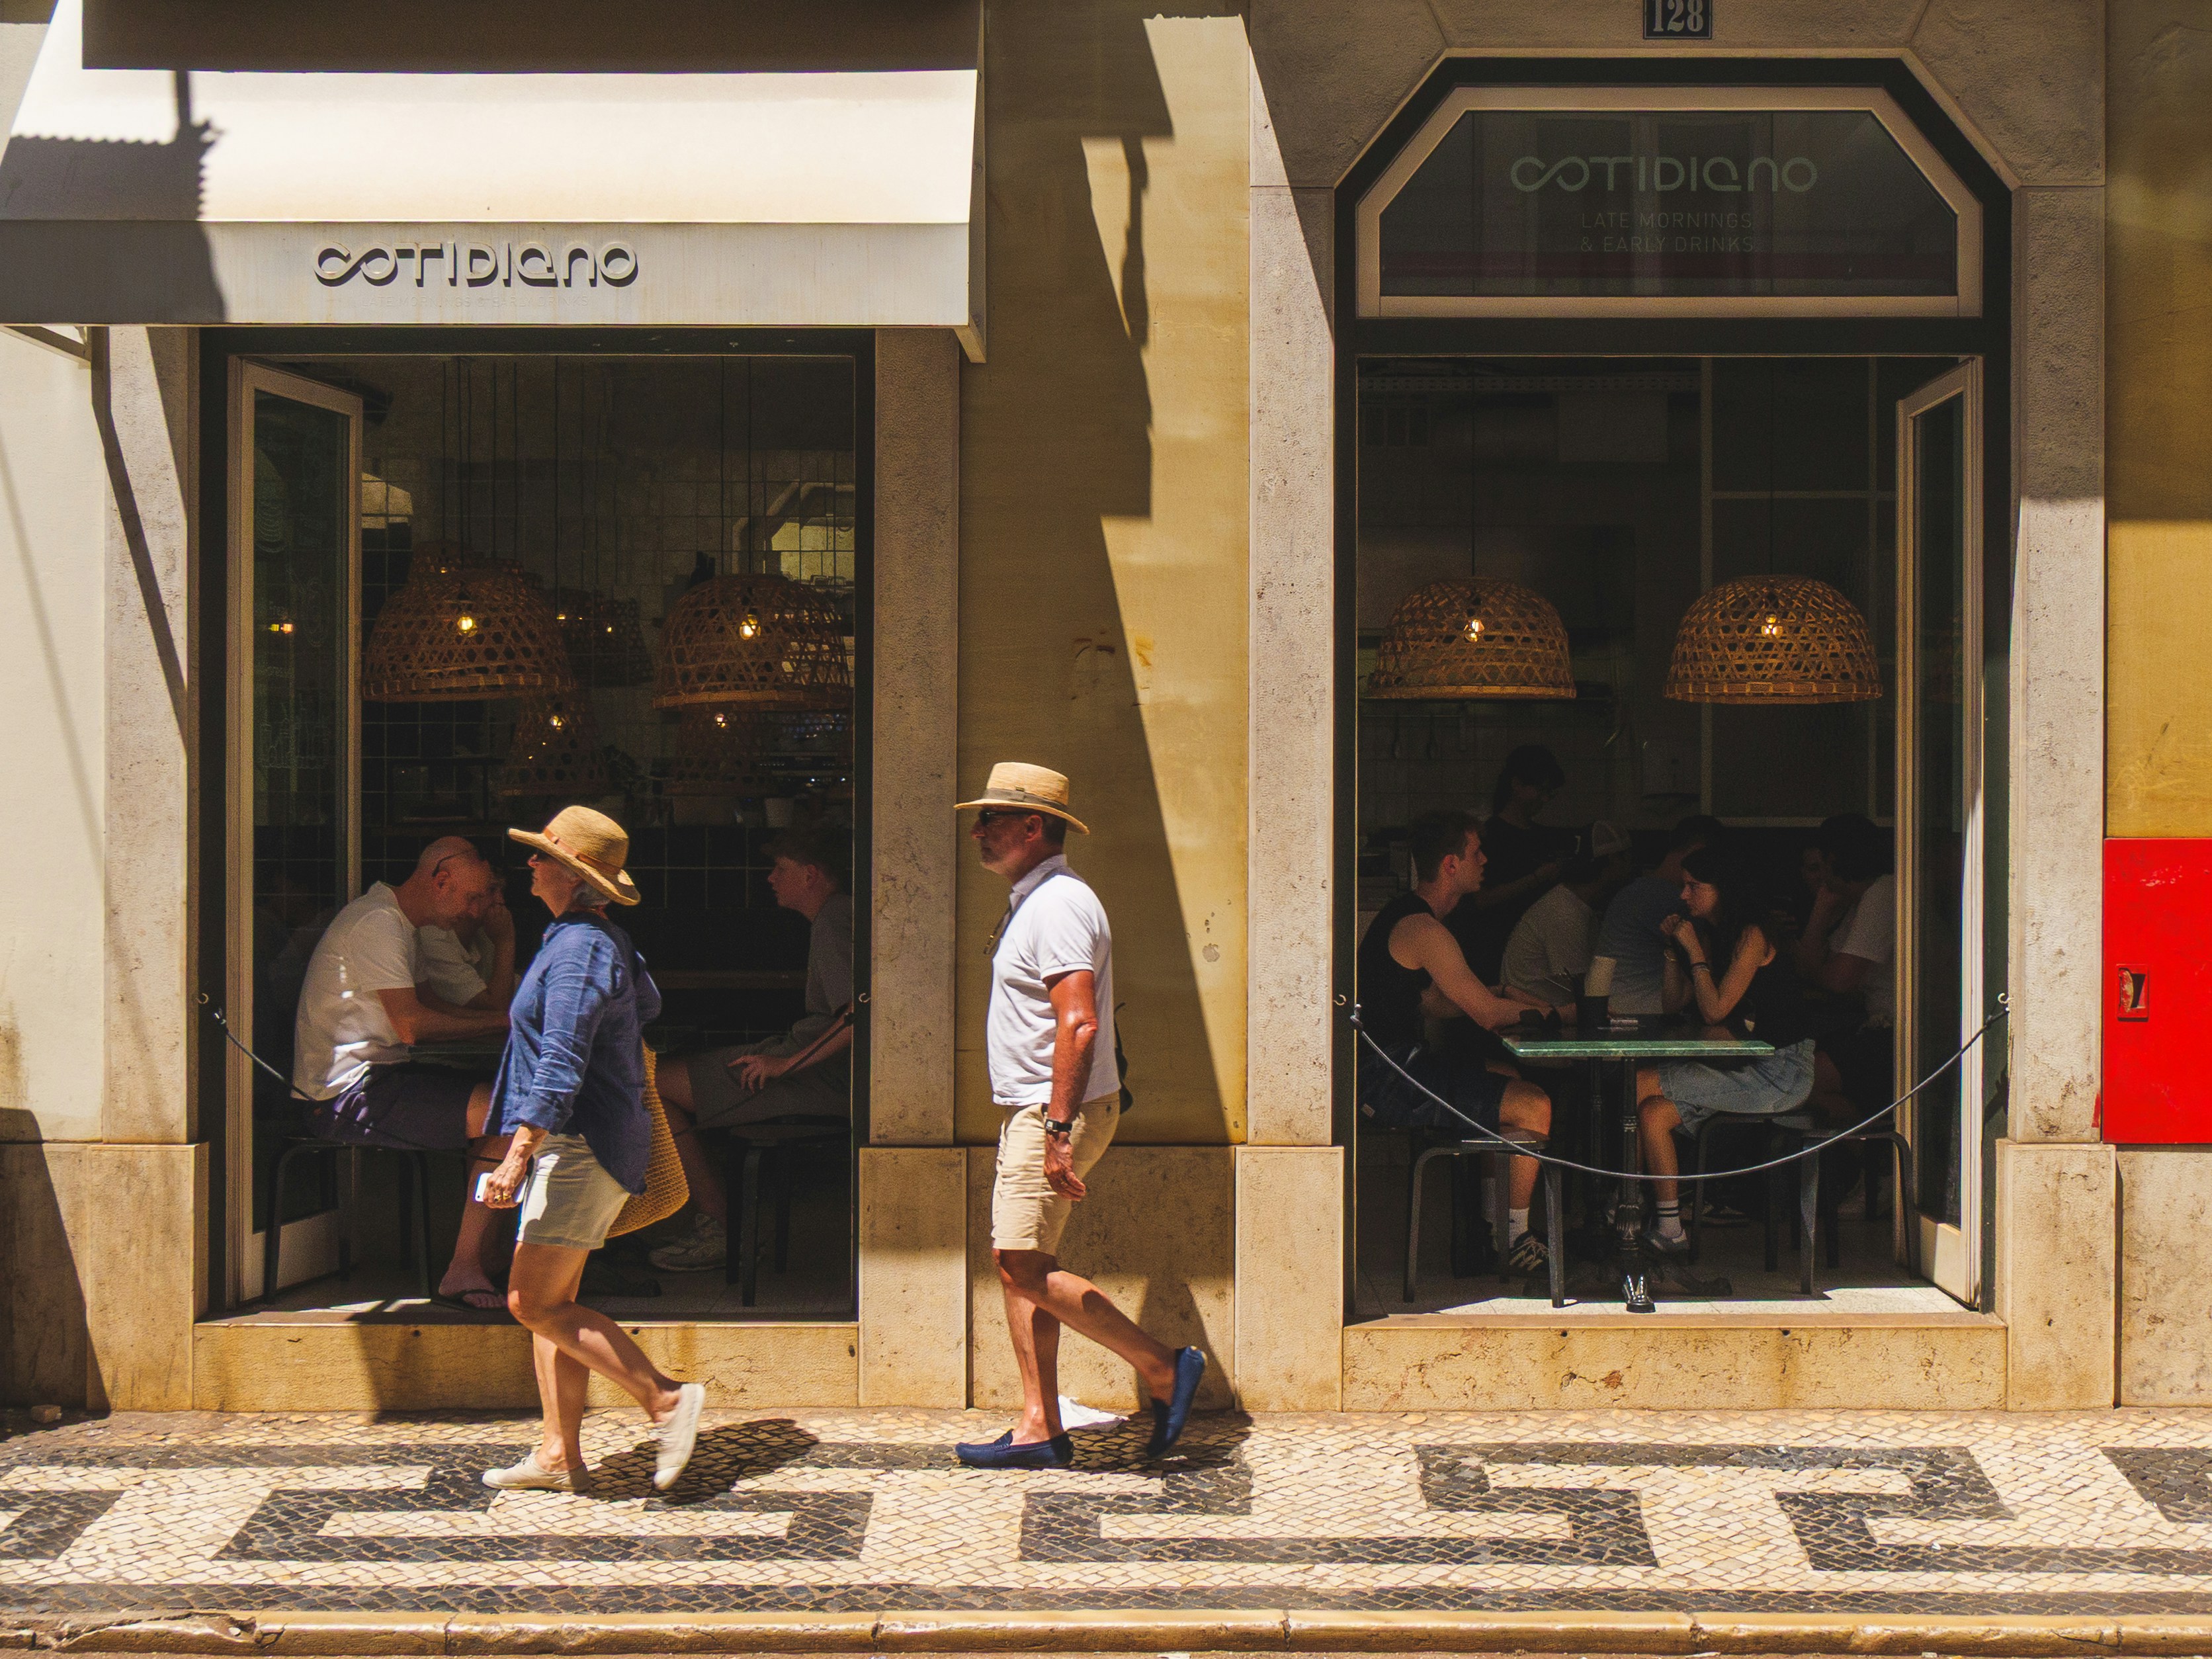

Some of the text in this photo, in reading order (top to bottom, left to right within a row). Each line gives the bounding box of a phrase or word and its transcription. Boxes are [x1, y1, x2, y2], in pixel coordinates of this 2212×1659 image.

[1653, 0, 1704, 32] 128
[1581, 212, 1752, 228] LATE MORNINGS
[1580, 237, 1754, 252] & EARLY DRINKS
